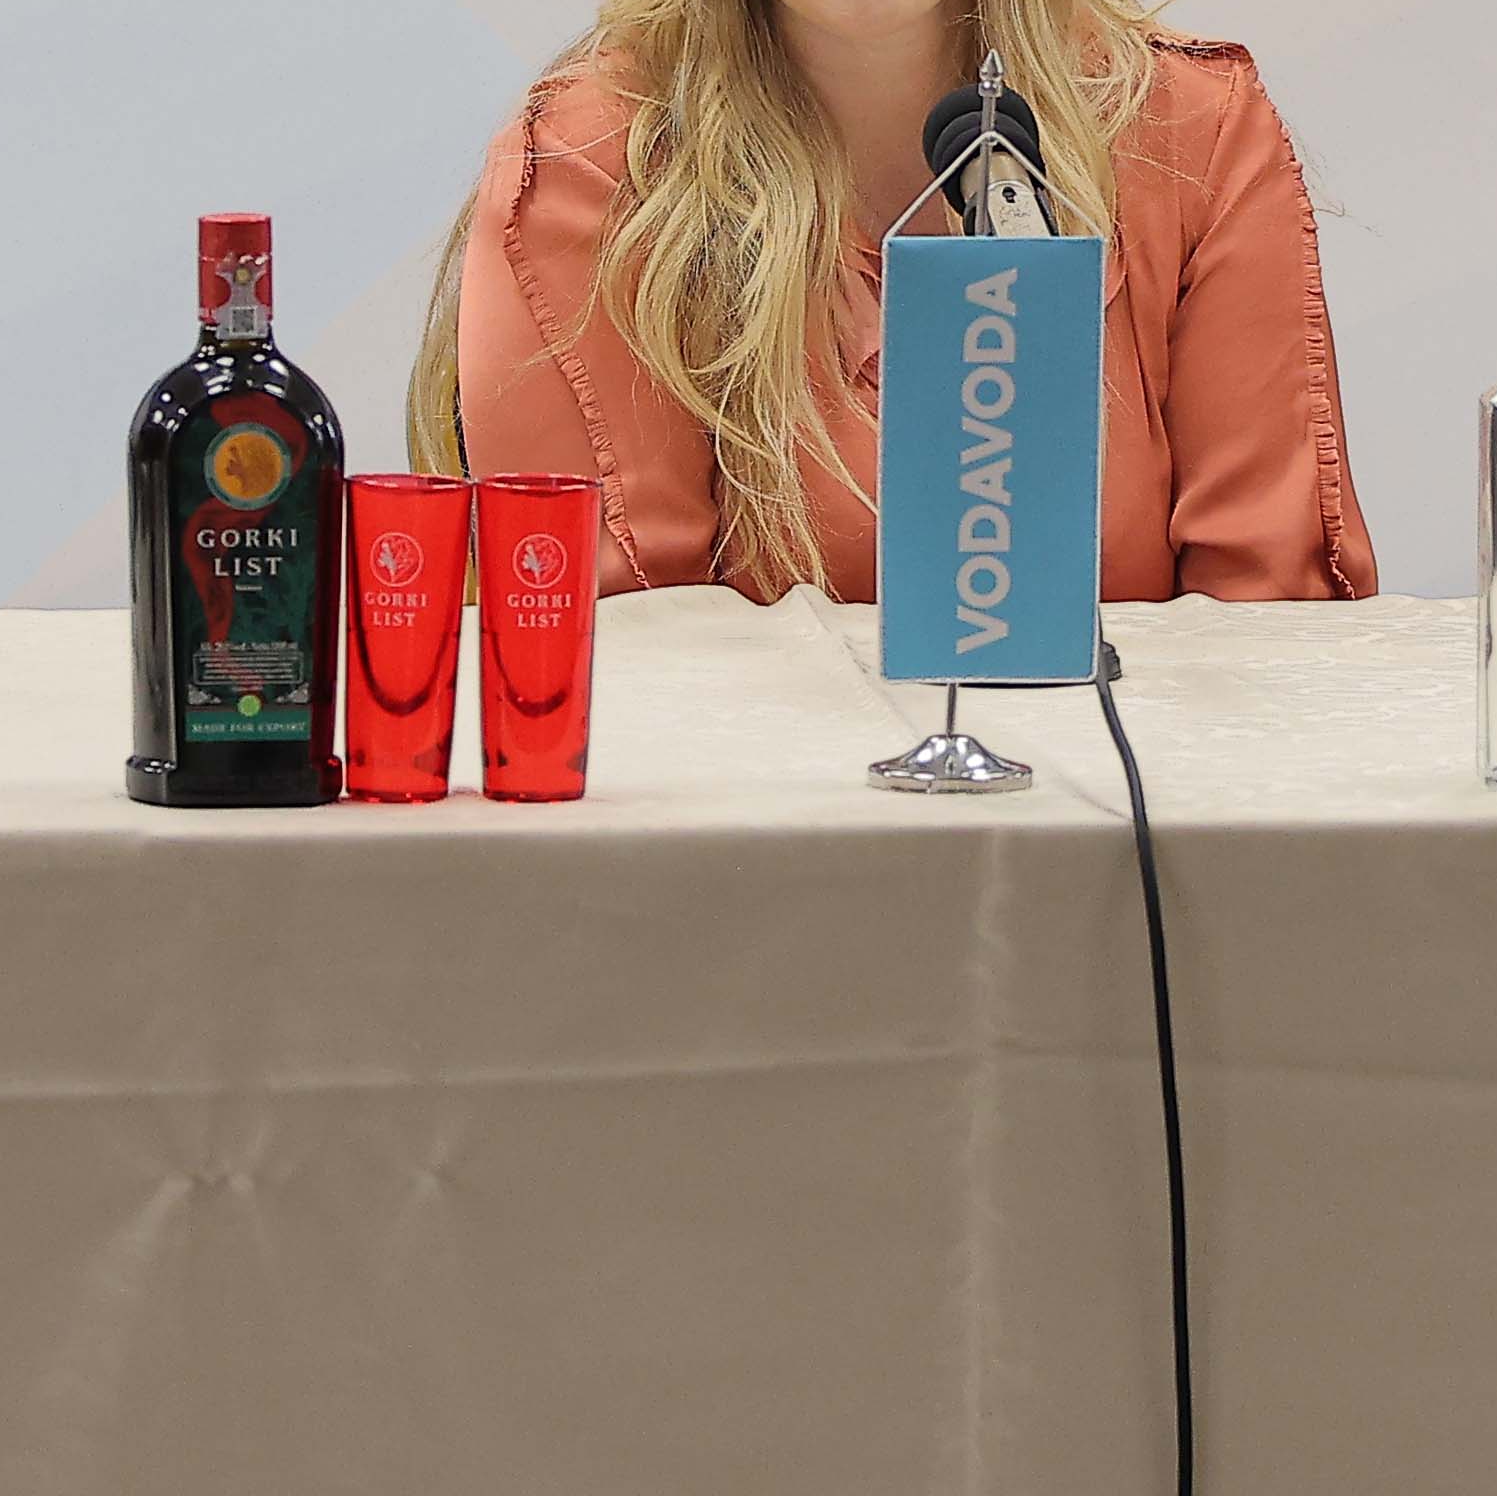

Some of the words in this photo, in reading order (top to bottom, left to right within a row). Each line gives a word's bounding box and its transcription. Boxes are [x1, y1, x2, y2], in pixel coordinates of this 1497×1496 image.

[954, 265, 1019, 655] VODAVODA
[196, 527, 298, 548] GORKI
[213, 556, 283, 577] LIST
[364, 591, 428, 608] GORKI
[506, 592, 573, 609] GORKI
[372, 610, 416, 626] LIST
[517, 612, 562, 629] LIST
